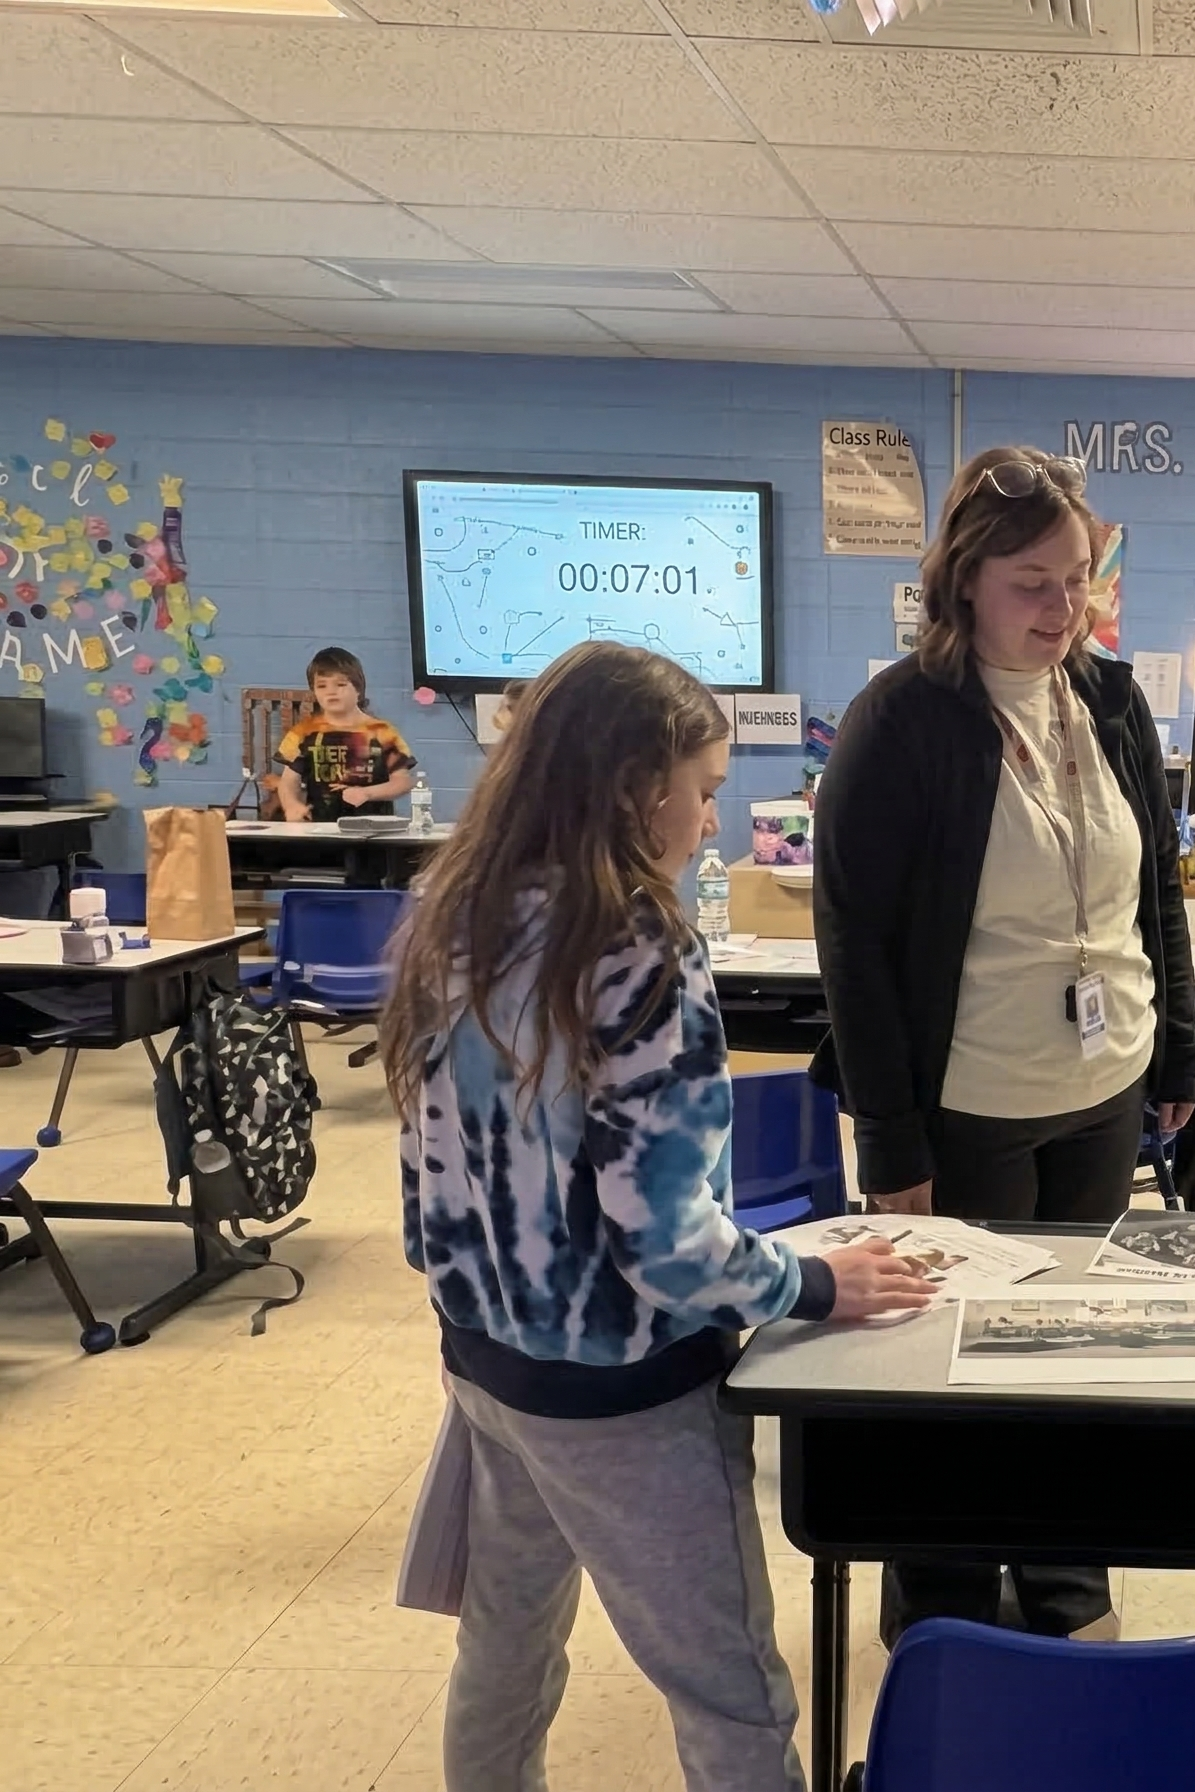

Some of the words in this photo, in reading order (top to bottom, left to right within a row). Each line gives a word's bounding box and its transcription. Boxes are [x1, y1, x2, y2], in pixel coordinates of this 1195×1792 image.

[829, 426, 870, 446] Class
[1063, 418, 1184, 476] MRS.
[579, 521, 646, 542] TIMER:
[558, 562, 698, 595] 00:07:01
